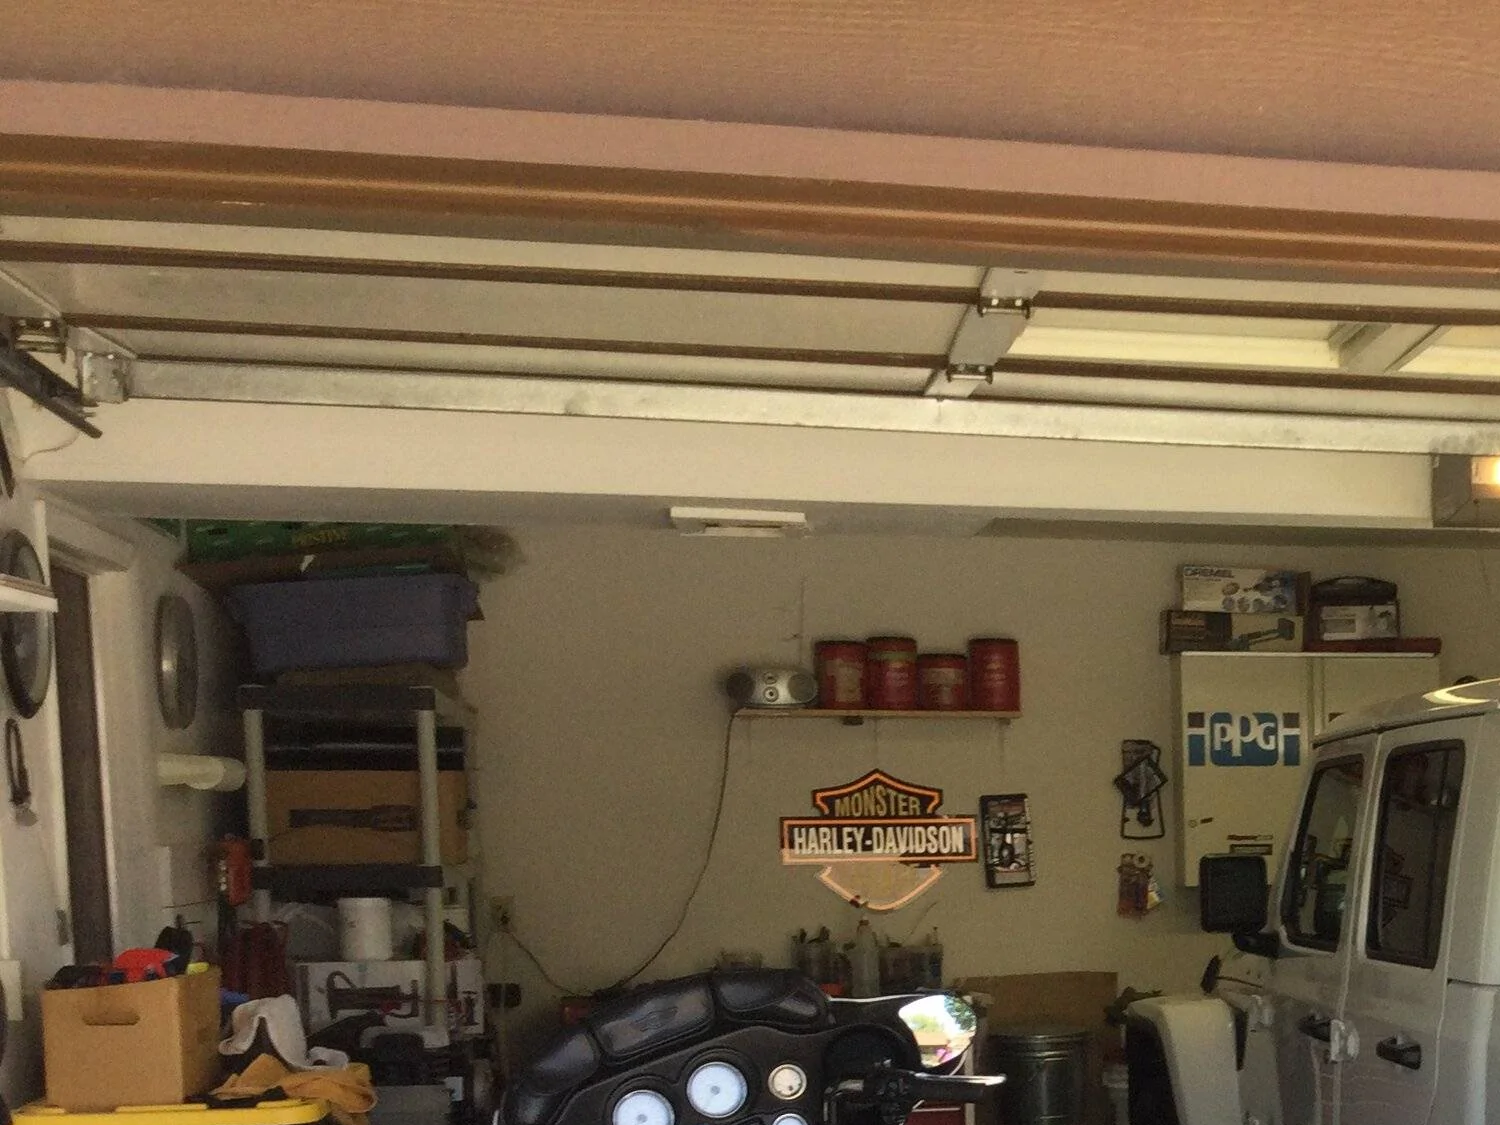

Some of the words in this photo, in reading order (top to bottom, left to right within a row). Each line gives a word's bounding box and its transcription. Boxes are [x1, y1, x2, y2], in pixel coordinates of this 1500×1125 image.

[1213, 712, 1277, 757] PPG
[834, 784, 921, 817] MONSTER
[793, 825, 965, 855] HARLEY-DAVIDSON
